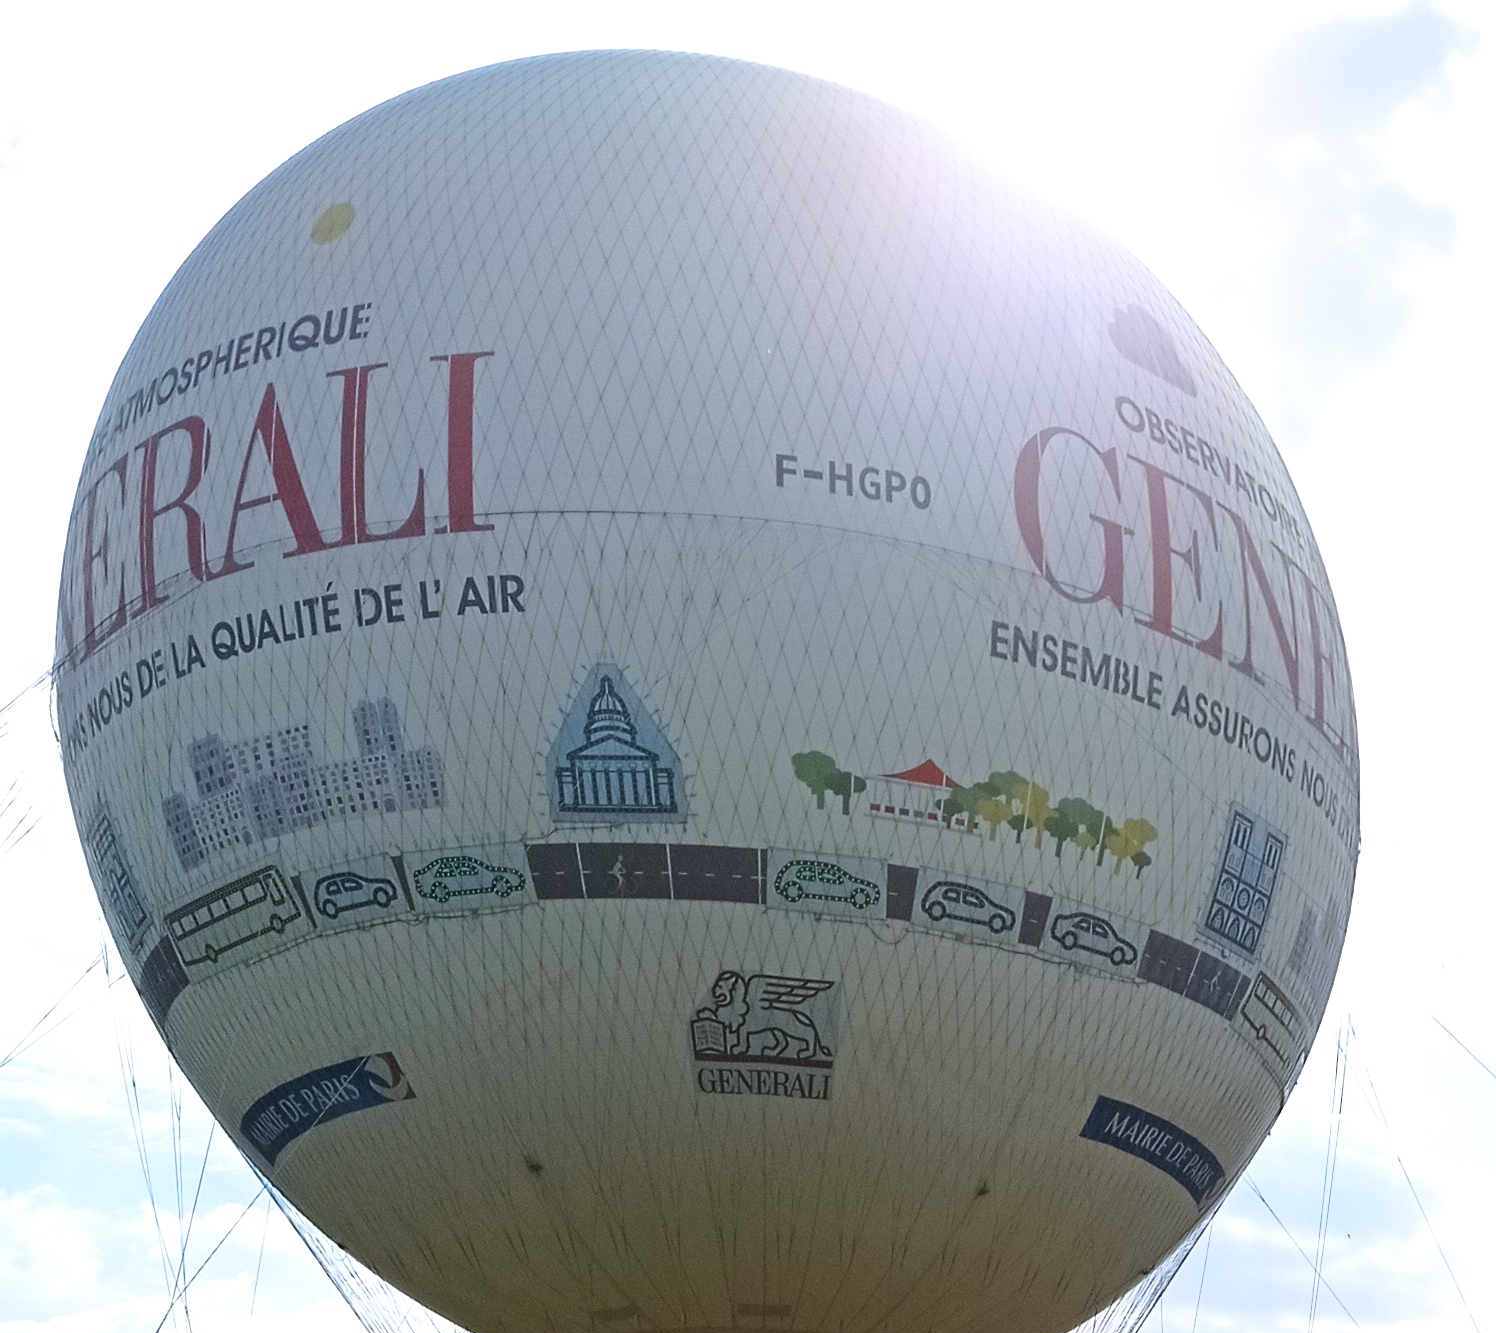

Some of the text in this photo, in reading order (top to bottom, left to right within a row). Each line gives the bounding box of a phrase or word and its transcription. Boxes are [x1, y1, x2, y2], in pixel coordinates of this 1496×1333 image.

[87, 670, 133, 738] NOUS
[136, 649, 168, 699] DE
[171, 634, 207, 679] LA
[211, 582, 342, 661] QUALITÉ
[354, 583, 406, 628] DE
[990, 619, 1163, 711] ENSEMBLE
[1171, 684, 1297, 783] ASSURONS
[1301, 759, 1339, 827] NOUS
[279, 1093, 310, 1122] DE
[301, 1074, 361, 1113] PARIS
[697, 1067, 832, 1100] GENERALI
[1104, 1111, 1216, 1190] MAIRIE DE PARIS
